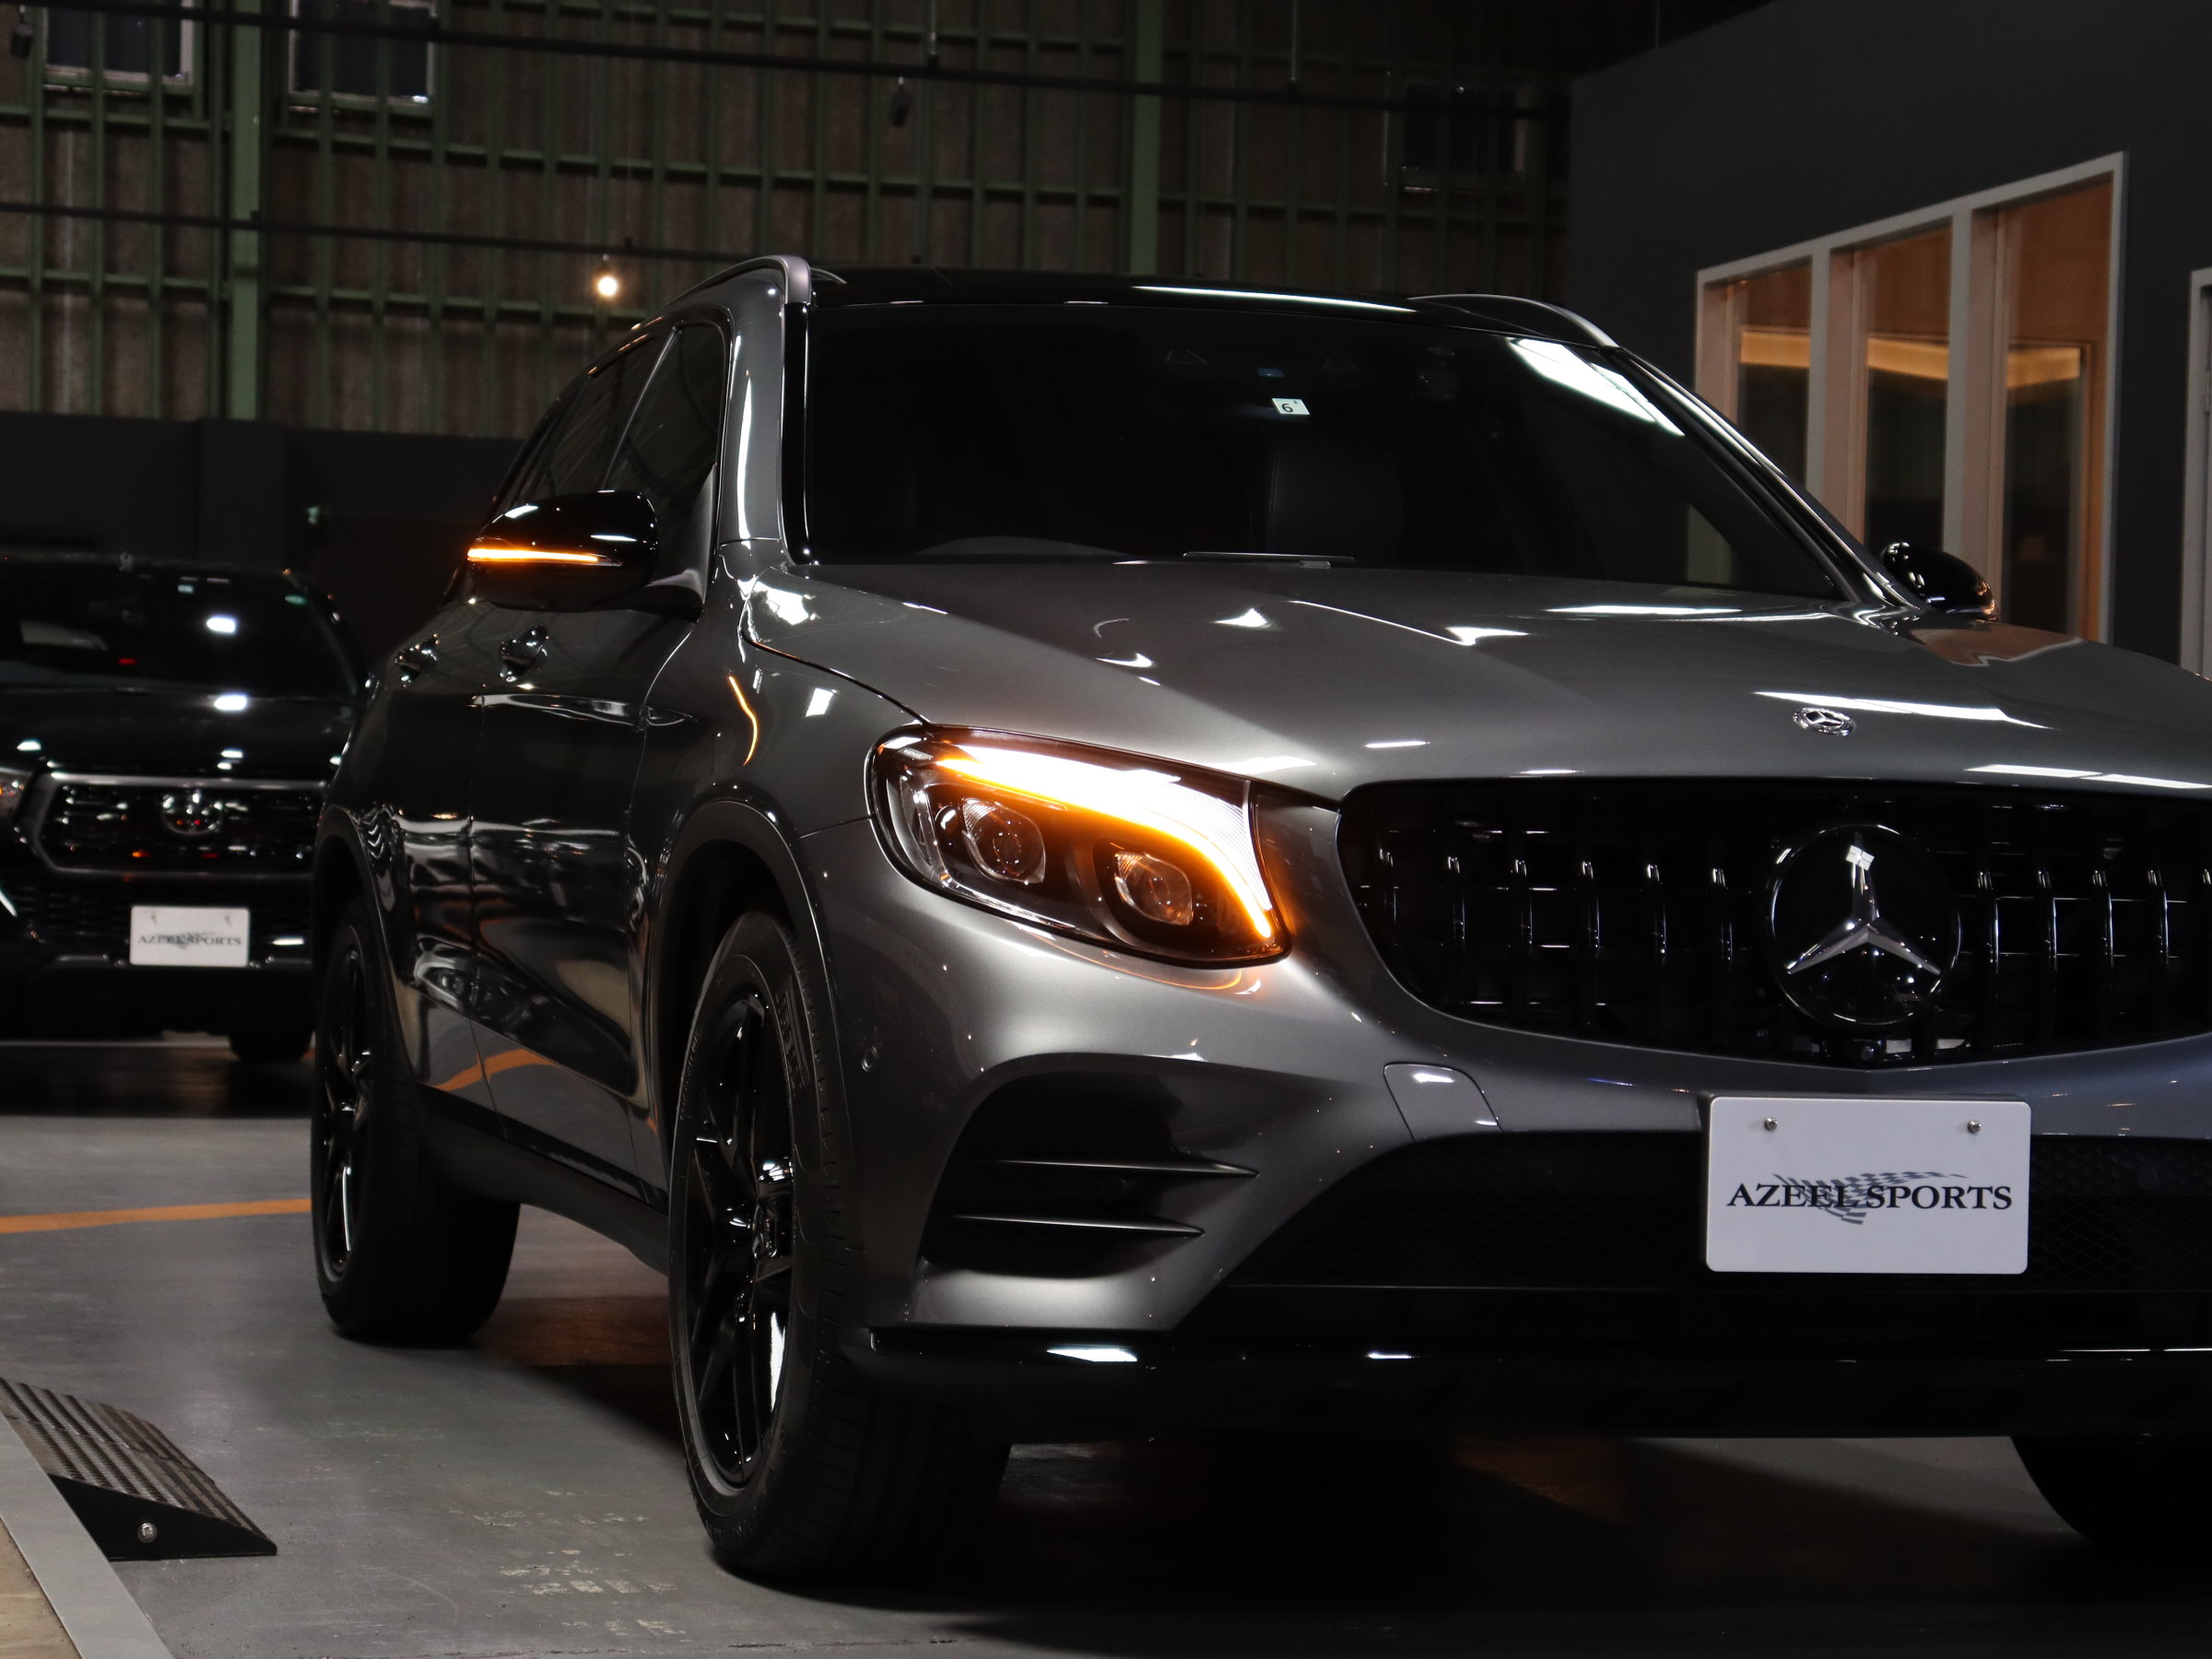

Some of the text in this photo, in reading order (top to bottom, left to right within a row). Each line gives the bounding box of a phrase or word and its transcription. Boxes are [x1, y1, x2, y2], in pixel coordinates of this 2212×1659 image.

[1282, 403, 1293, 412] 6
[187, 935, 241, 946] SPORTS
[1726, 1182, 2012, 1210] AZEEL SPORTS
